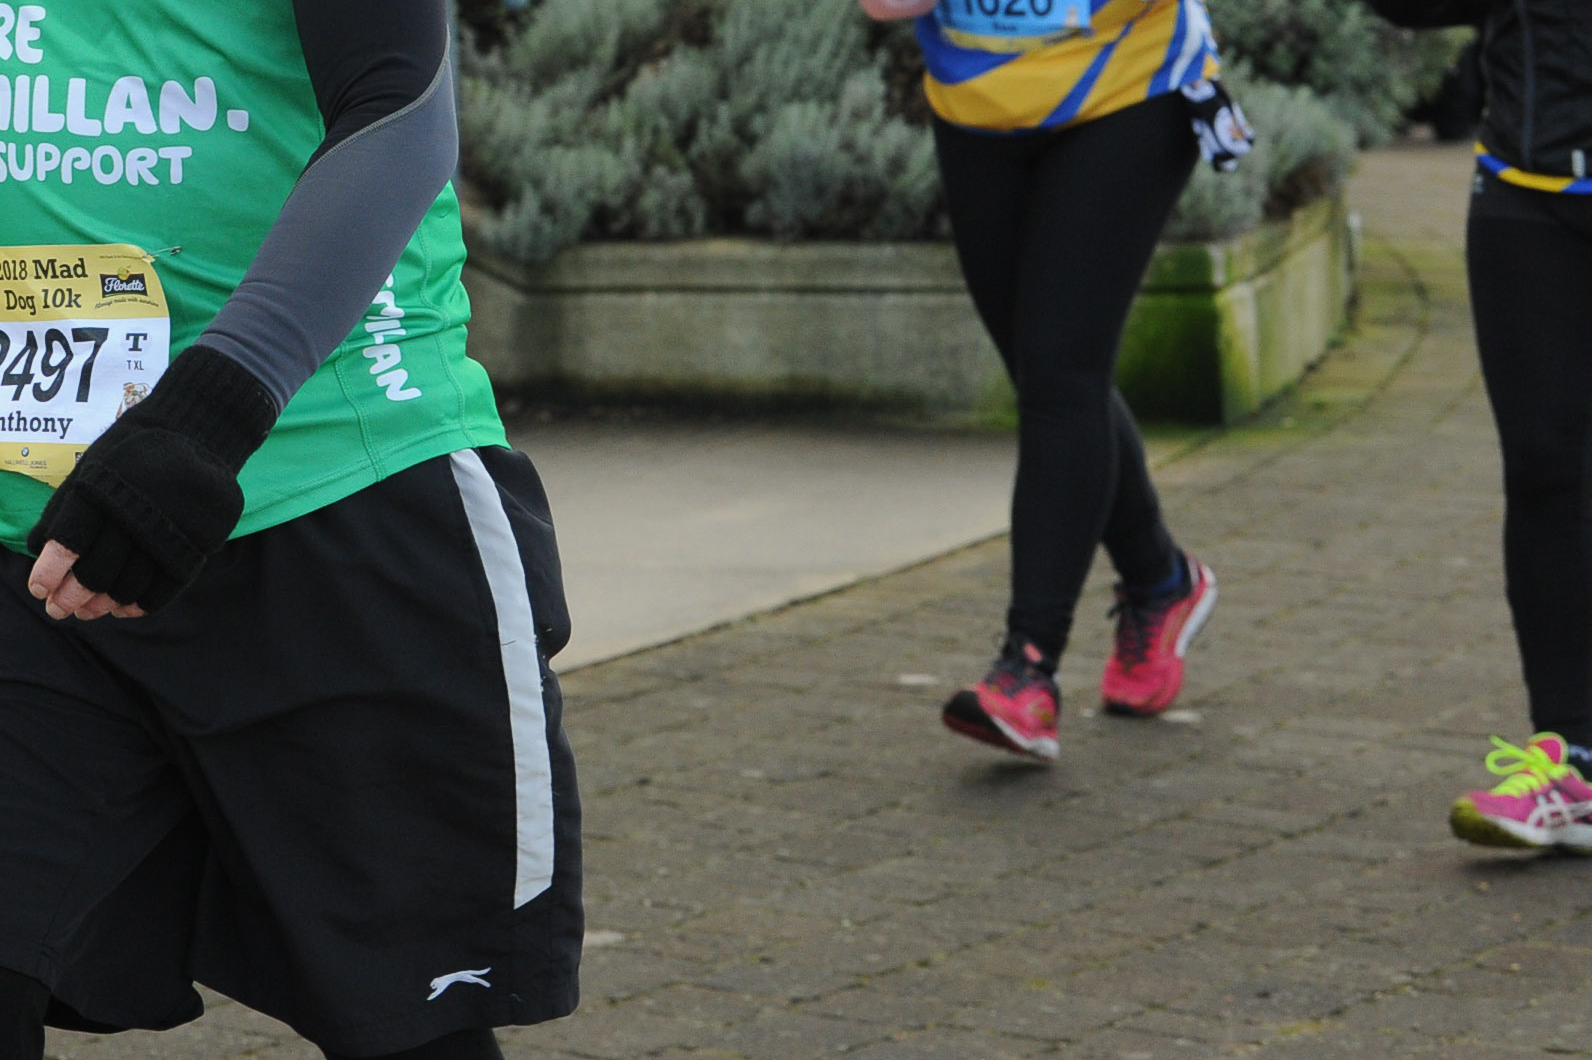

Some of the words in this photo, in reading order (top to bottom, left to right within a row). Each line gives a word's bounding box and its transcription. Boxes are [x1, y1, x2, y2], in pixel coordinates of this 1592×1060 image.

[33, 258, 88, 280] Mad
[104, 277, 145, 293] Florette
[4, 289, 36, 315] Dog
[41, 288, 82, 309] 10k
[125, 333, 148, 351] T
